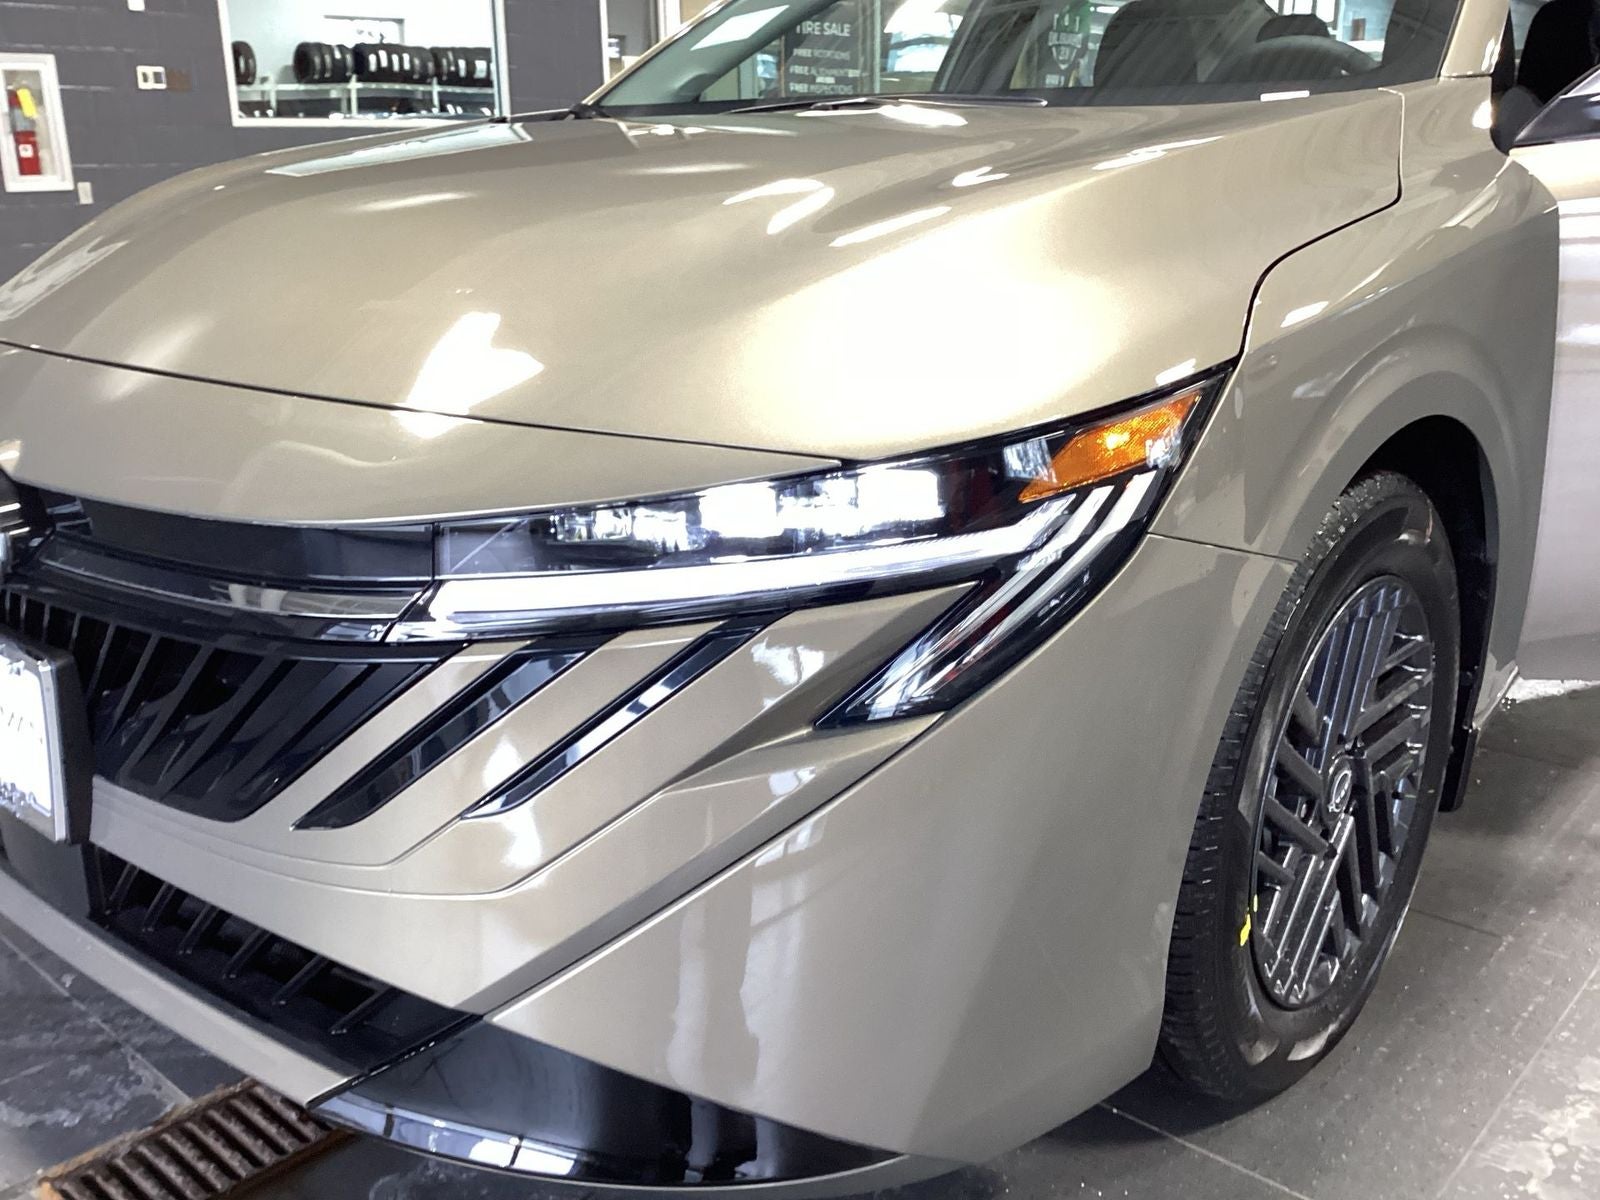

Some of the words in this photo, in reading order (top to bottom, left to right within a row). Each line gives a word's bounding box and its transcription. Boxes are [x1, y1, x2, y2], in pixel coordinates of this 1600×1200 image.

[823, 22, 851, 36] SALE
[790, 65, 809, 75] FREE
[789, 82, 809, 93] FREE
